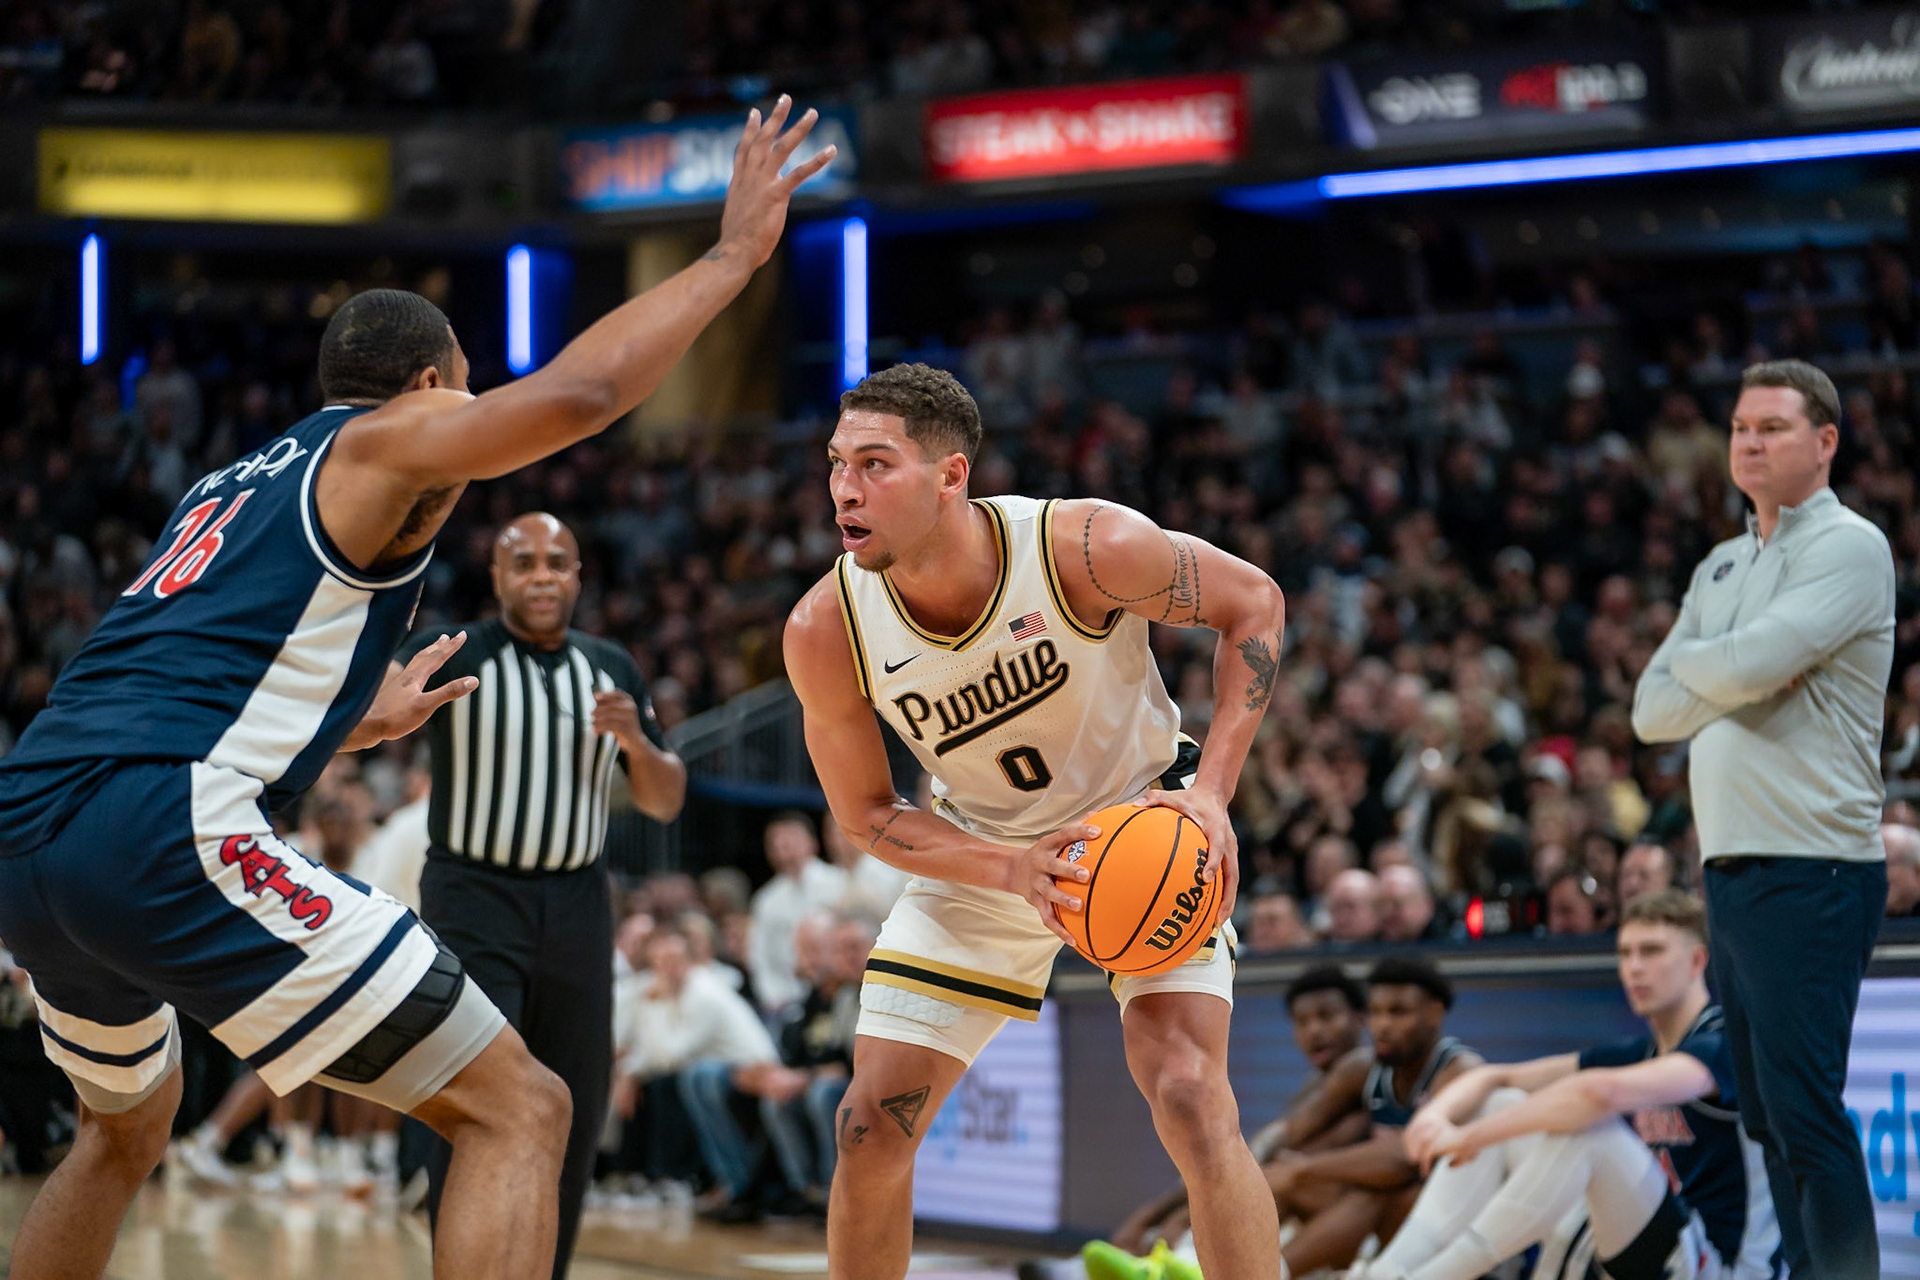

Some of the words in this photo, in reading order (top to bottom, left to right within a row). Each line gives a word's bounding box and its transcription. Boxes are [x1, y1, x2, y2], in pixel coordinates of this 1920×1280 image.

[121, 488, 256, 599] 16
[891, 639, 1069, 745] Purdue
[995, 744, 1053, 792] 0
[219, 834, 333, 930] CATS
